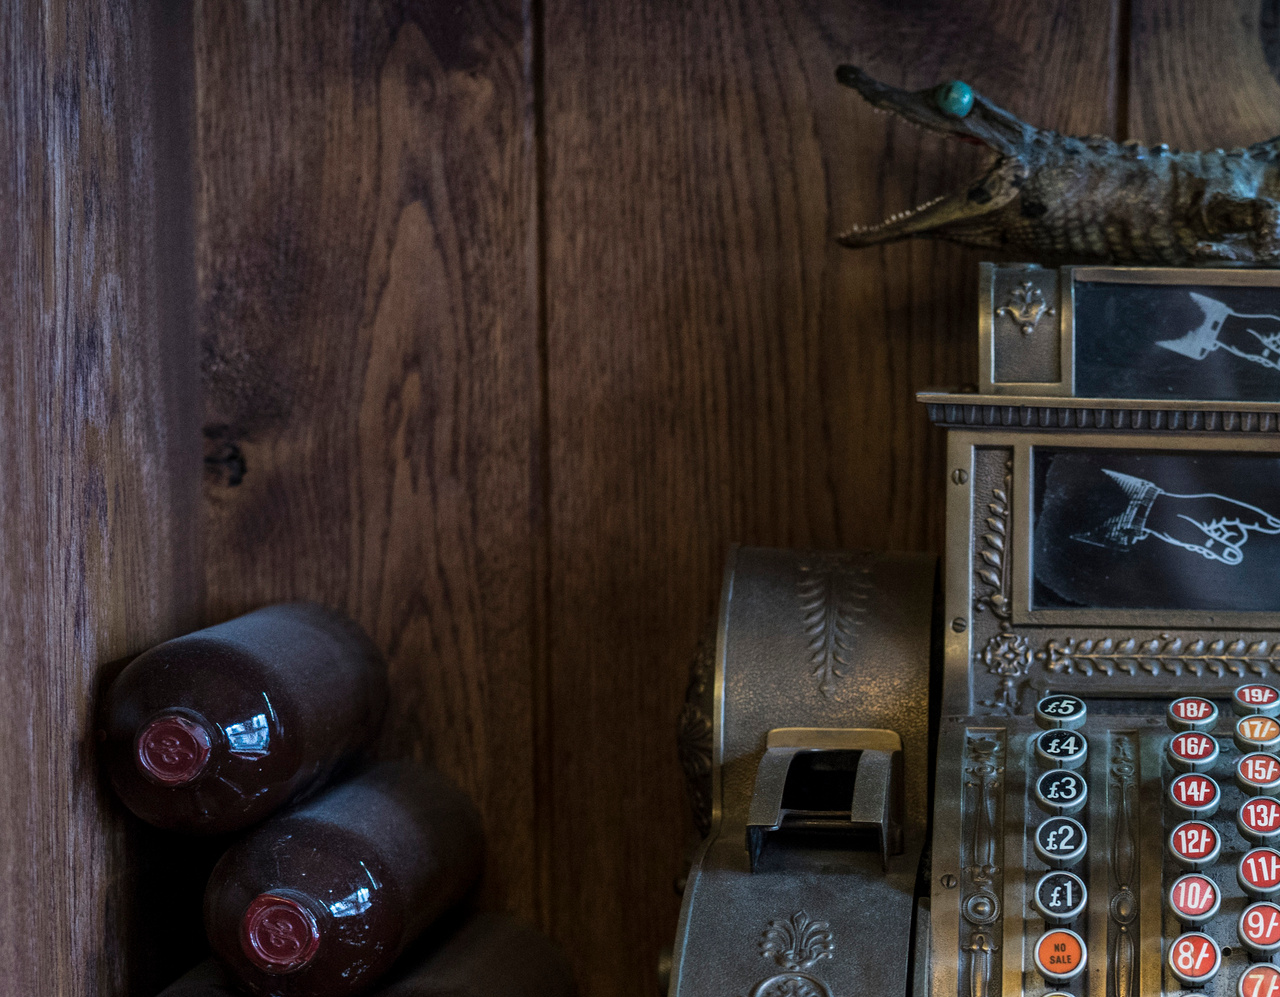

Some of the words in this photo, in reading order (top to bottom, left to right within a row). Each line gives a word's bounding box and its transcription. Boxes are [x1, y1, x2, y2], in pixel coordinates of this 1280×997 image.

[1044, 700, 1077, 713] £5
[1046, 738, 1078, 755] £4
[1048, 778, 1077, 799] £3
[1046, 826, 1075, 850] £2
[1049, 881, 1072, 907] £1
[1054, 944, 1066, 952] NO
[1049, 955, 1071, 964] SALE
